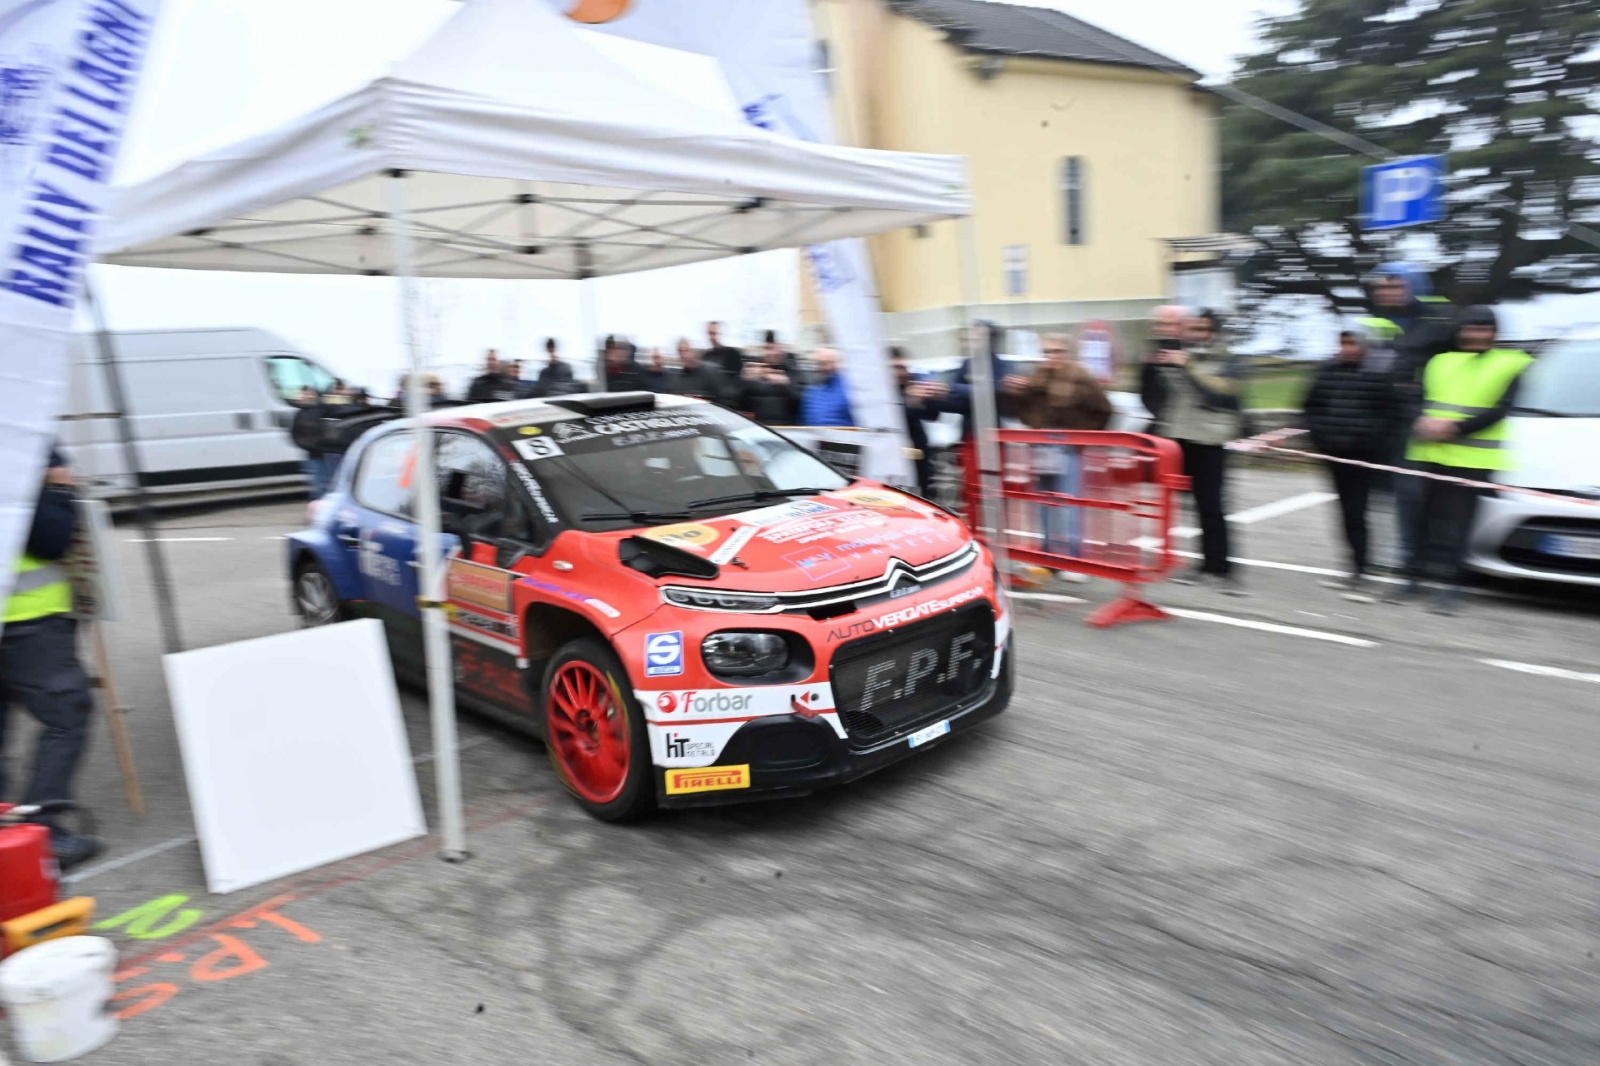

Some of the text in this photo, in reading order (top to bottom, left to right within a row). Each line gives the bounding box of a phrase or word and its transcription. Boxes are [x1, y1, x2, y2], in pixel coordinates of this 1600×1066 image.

[1372, 167, 1432, 222] P
[528, 438, 551, 456] 8
[681, 691, 753, 713] Forbar
[674, 770, 741, 788] PIRELLI
